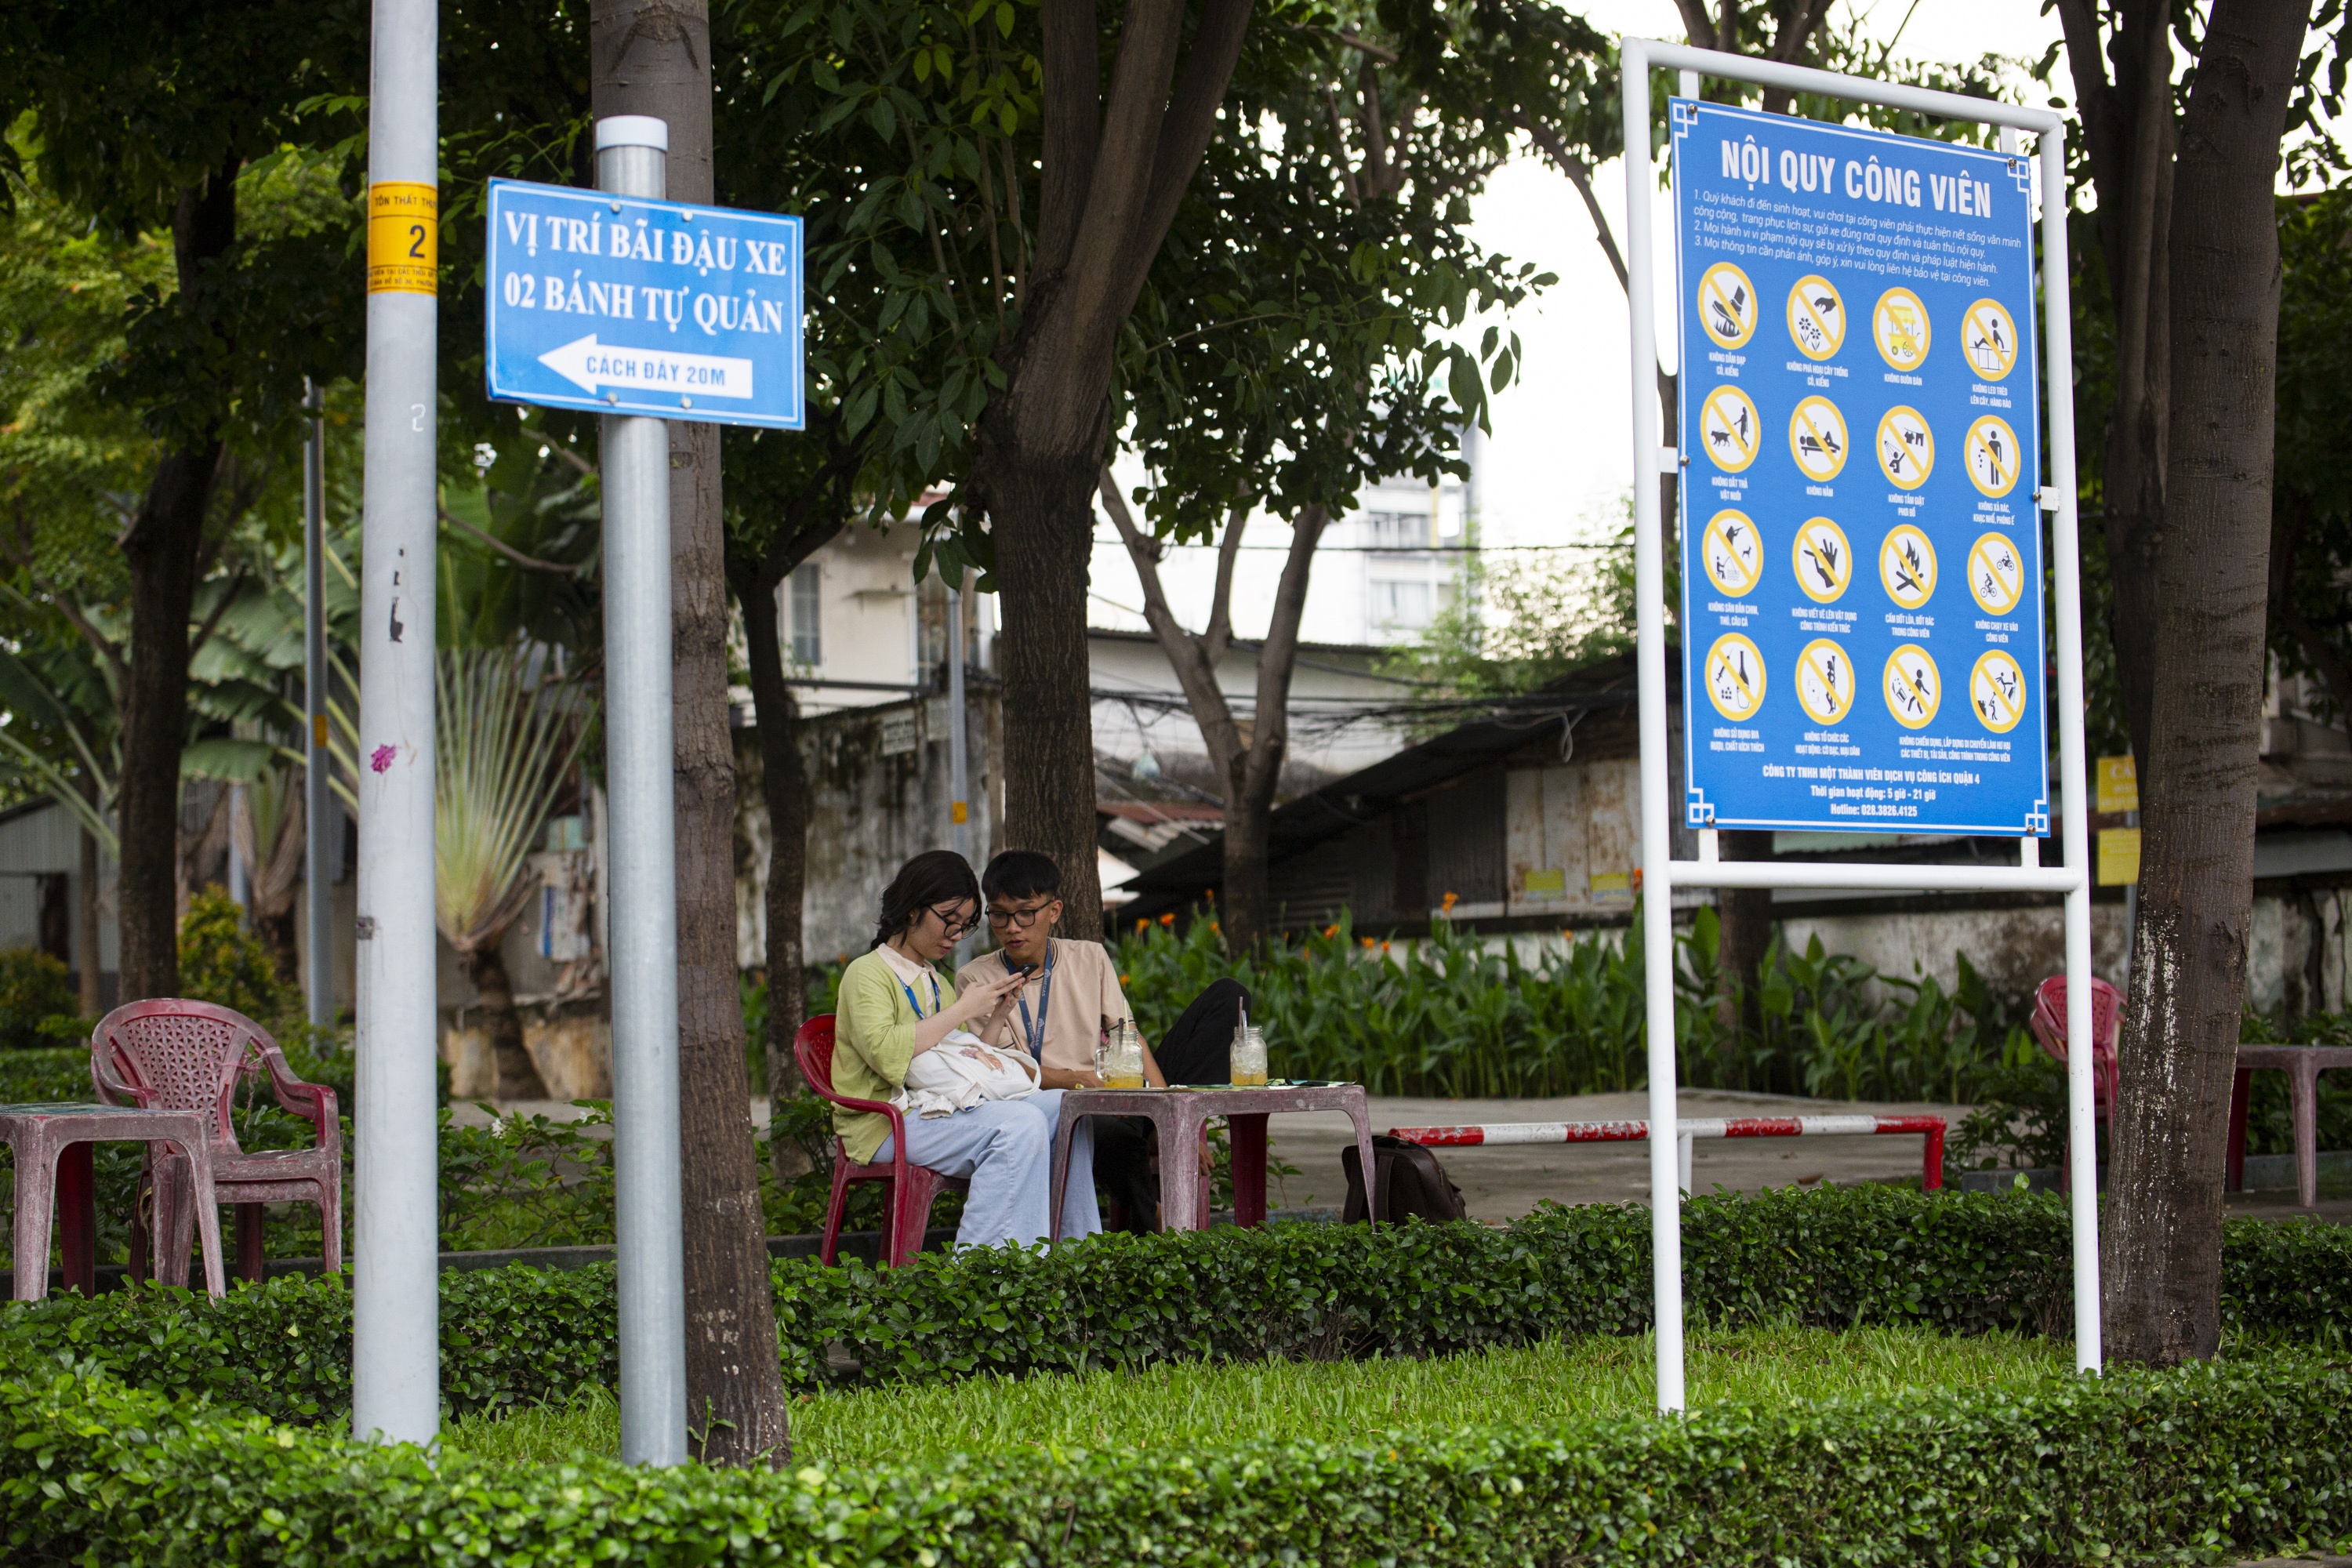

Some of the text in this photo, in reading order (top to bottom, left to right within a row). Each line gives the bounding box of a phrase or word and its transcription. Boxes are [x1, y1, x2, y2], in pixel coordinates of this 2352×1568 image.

[375, 195, 390, 206] TÔN
[1722, 134, 1991, 218] NỘI QUY CÔNG VIÊN
[409, 224, 426, 259] 2
[504, 211, 786, 277] VỊ TRÍ BÃI ĐẬU XE
[1693, 205, 1985, 260] công cộng, trang phục lịch sự, gửi xe đúng nơi quy định và tuân thủ nội quy.
[1695, 189, 2021, 248] 1. Quý khách đi đến sinh hoạt, vui chơi tại công viên phải thực hiện nết sống văn minh
[1694, 220, 1702, 230] 2.
[1704, 221, 1719, 234] Mọi
[1721, 223, 1741, 236] hành
[1760, 230, 1784, 243] phạm
[1785, 234, 1798, 246] nội
[1799, 238, 1814, 249] quy
[1816, 238, 1825, 249] sẽ
[1827, 239, 1835, 252] bị
[1836, 241, 1847, 252] xử
[1848, 242, 1855, 256] lý
[1857, 244, 1875, 256] theo
[1876, 249, 1891, 260] quy
[1892, 249, 1909, 260] định
[1911, 252, 1920, 263] và
[1922, 254, 1941, 267] pháp
[1943, 256, 1958, 268] luật
[1959, 258, 1976, 270] hiện
[1977, 261, 1998, 273] hành.
[1694, 234, 1990, 286] 3. Mọi thông tin cần phản ánh, góp ý, xin vui lòng liên hệ bảo vệ tại công viên.
[504, 268, 783, 336] 02 BÁNH TỰ QUẢN
[586, 354, 636, 377] CÁCH
[687, 366, 725, 386] 20M
[1762, 763, 1980, 786] CÔNG TY TNHH MỘT THÀNH VIÊN DỊCH VỤ CÔNG ÍCH QUẬN 4
[1810, 785, 1827, 797] Thời
[1828, 786, 1845, 799] gian
[1846, 786, 1864, 800] hoạt
[1864, 787, 1886, 800] động:
[1887, 788, 1893, 798] 5
[1894, 788, 1906, 800] giờ
[1913, 789, 1922, 799] 21
[1924, 789, 1936, 802] giờ
[1831, 804, 1917, 816] Hotline: 028.3826.4125
